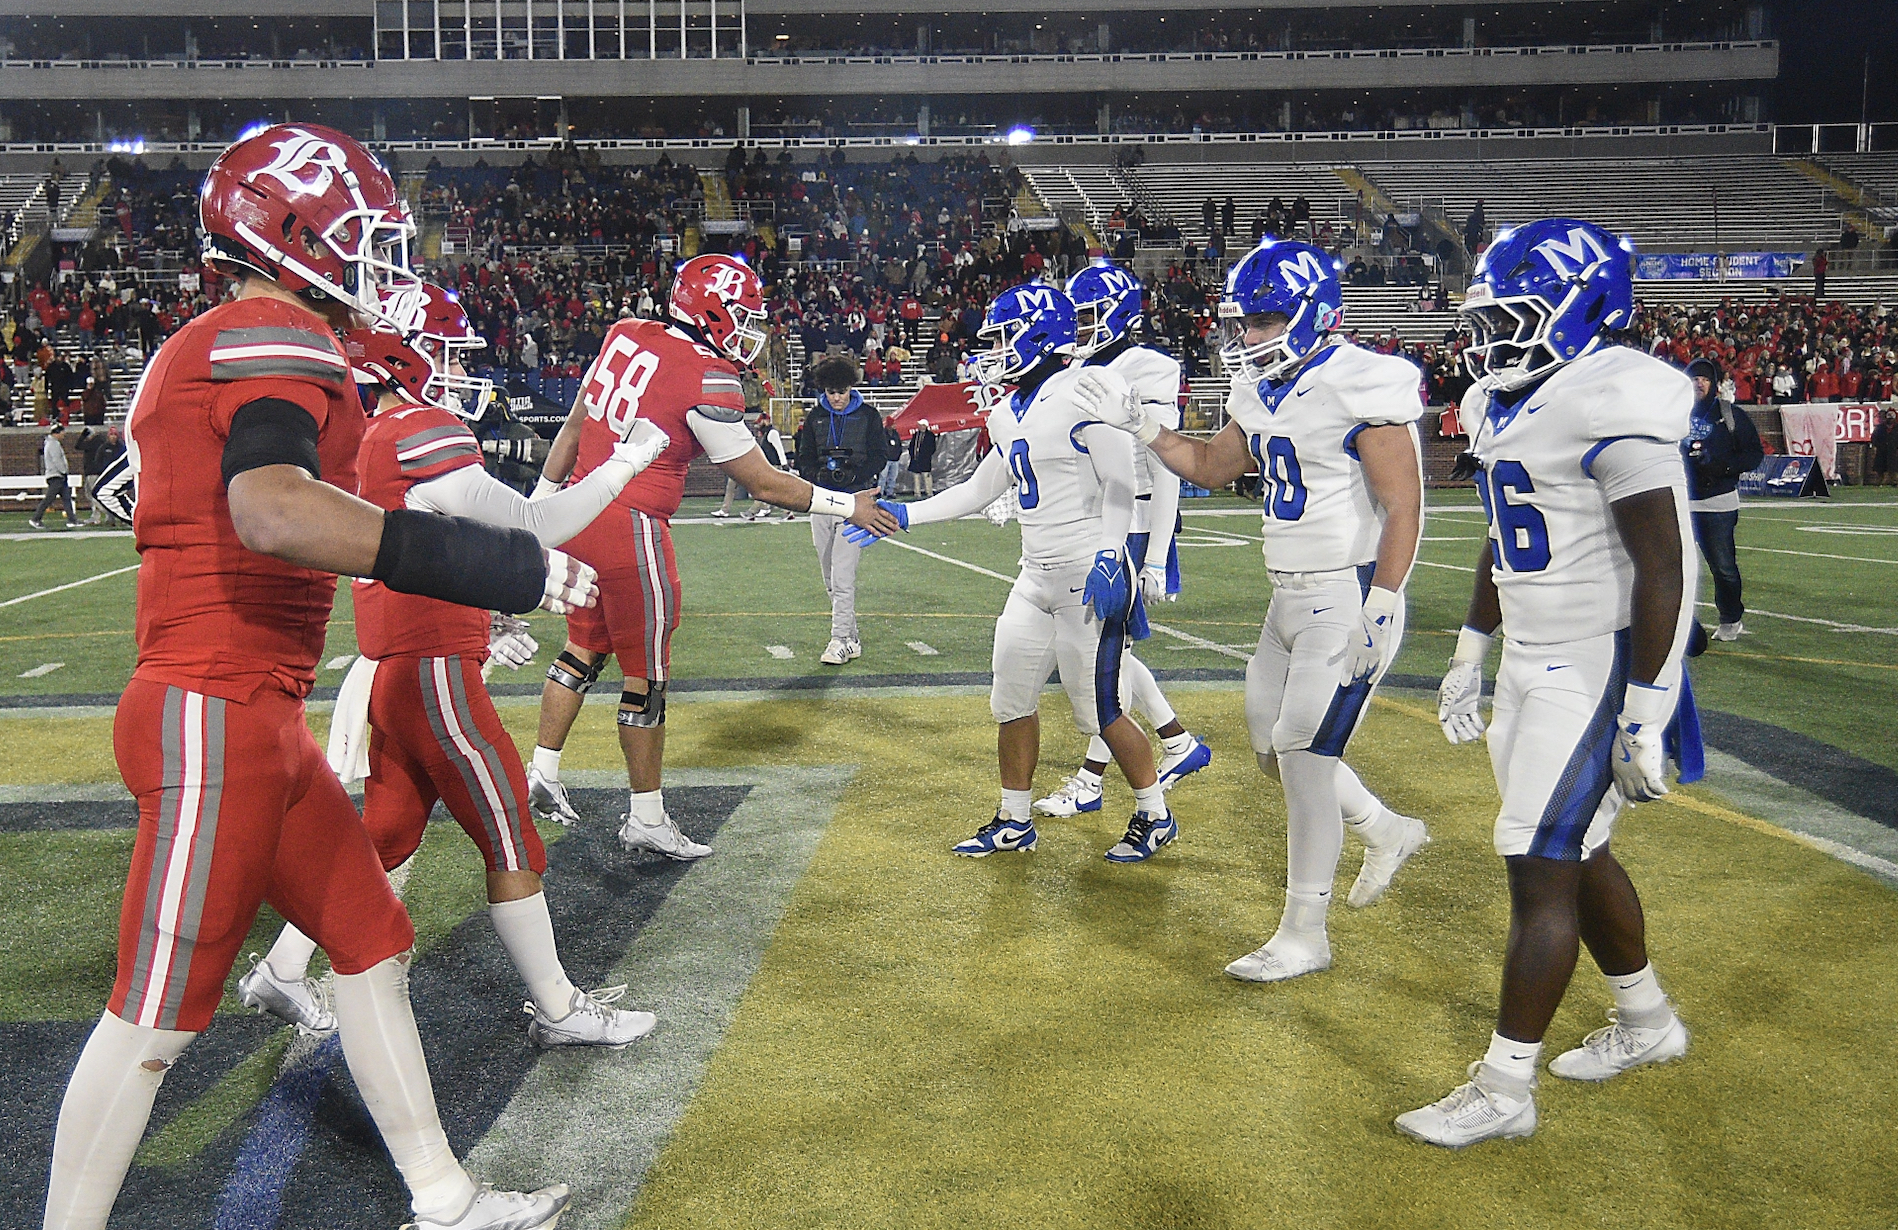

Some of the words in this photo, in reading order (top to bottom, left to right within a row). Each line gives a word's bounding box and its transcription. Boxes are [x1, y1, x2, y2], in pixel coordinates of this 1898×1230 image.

[248, 128, 347, 197] B
[1278, 251, 1329, 297] M
[1530, 228, 1612, 281] M
[1681, 257, 1709, 267] HOME
[704, 263, 747, 301] B
[1015, 288, 1056, 315] M
[1099, 270, 1136, 296] M
[583, 333, 660, 436] 58
[963, 383, 1006, 416] B
[518, 415, 568, 423] SPORTS.COM
[1009, 438, 1040, 510] 0
[1250, 433, 1308, 521] 10
